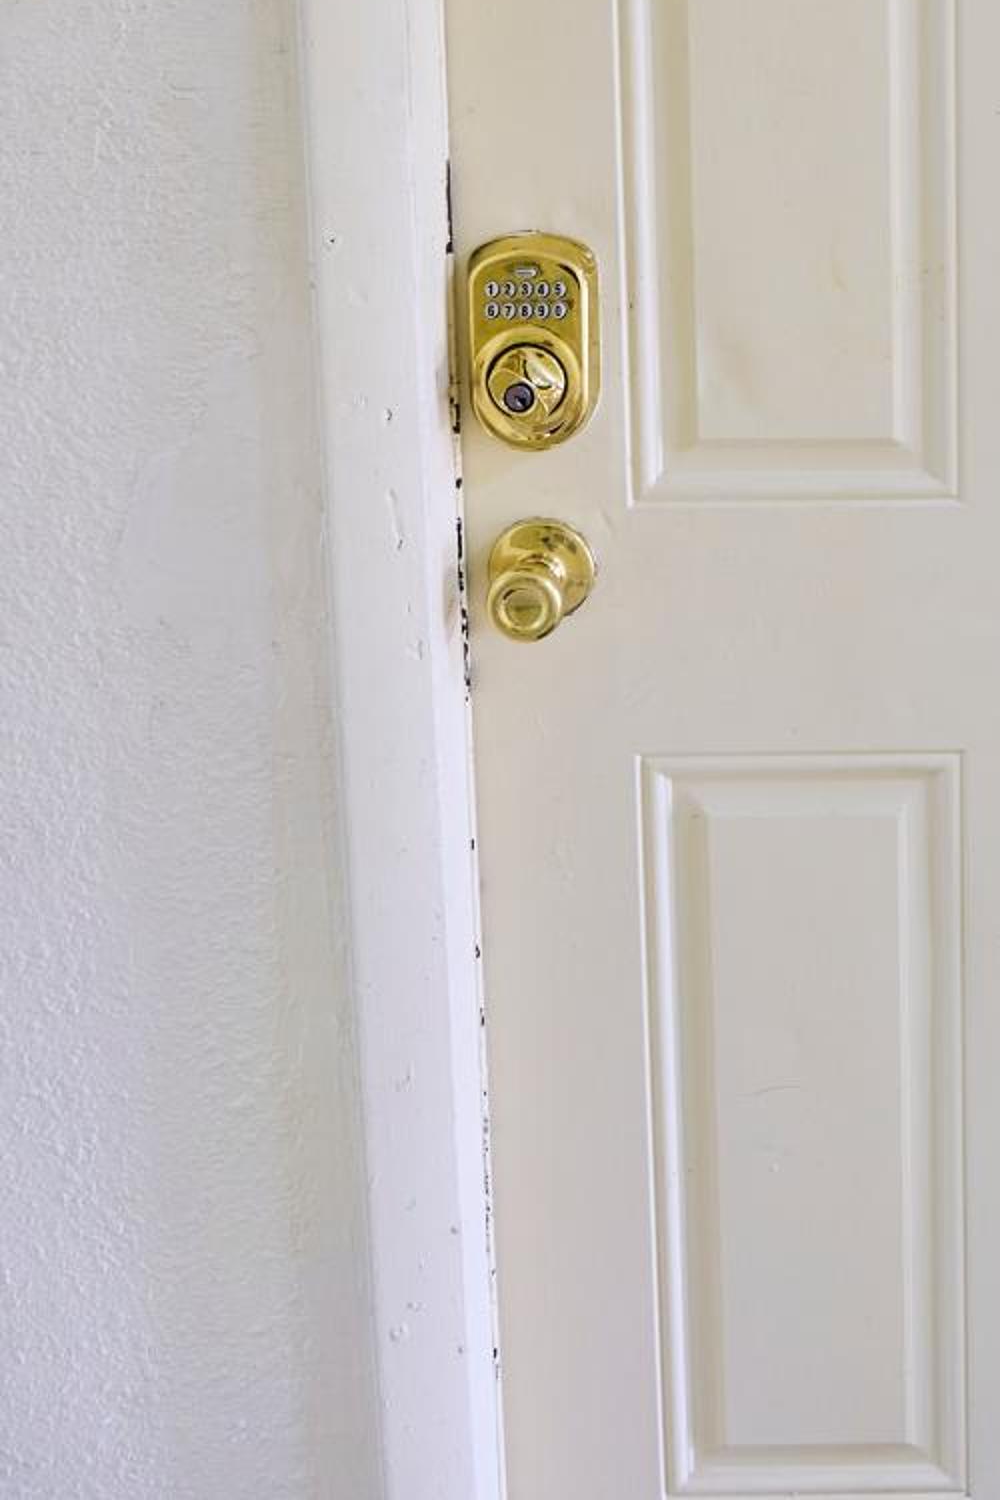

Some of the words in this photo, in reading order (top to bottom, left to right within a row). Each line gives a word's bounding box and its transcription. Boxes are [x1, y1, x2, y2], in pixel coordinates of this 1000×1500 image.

[487, 283, 494, 296] 1
[503, 283, 511, 296] 2
[521, 283, 529, 296] 3
[537, 283, 545, 296] 4
[554, 283, 562, 296] 5
[487, 305, 495, 317] 6
[504, 305, 512, 317] 7
[521, 305, 529, 317] 8
[537, 305, 545, 317] 9
[554, 305, 562, 317] 0
